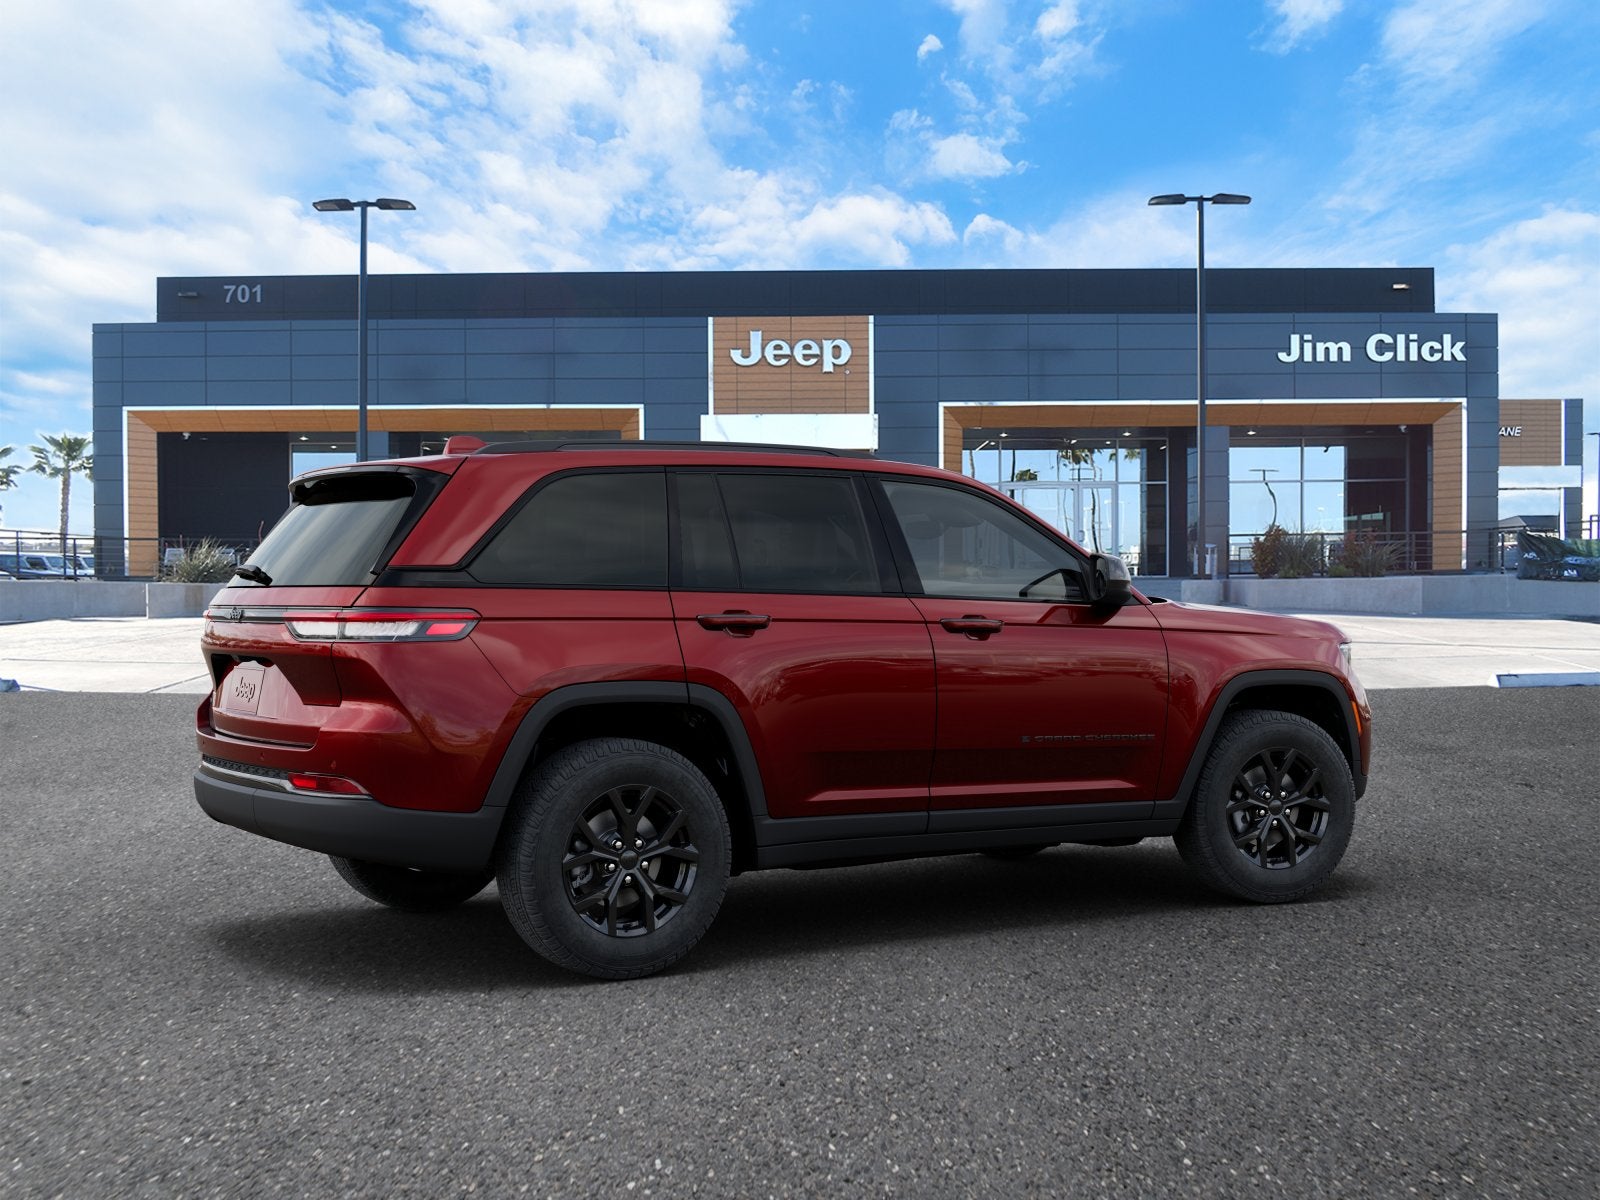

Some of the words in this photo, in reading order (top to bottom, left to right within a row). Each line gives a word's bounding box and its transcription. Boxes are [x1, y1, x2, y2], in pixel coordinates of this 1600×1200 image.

[223, 284, 262, 303] 701
[729, 330, 852, 373] Jeep
[1277, 333, 1351, 362] Jim
[1366, 333, 1467, 362] Click
